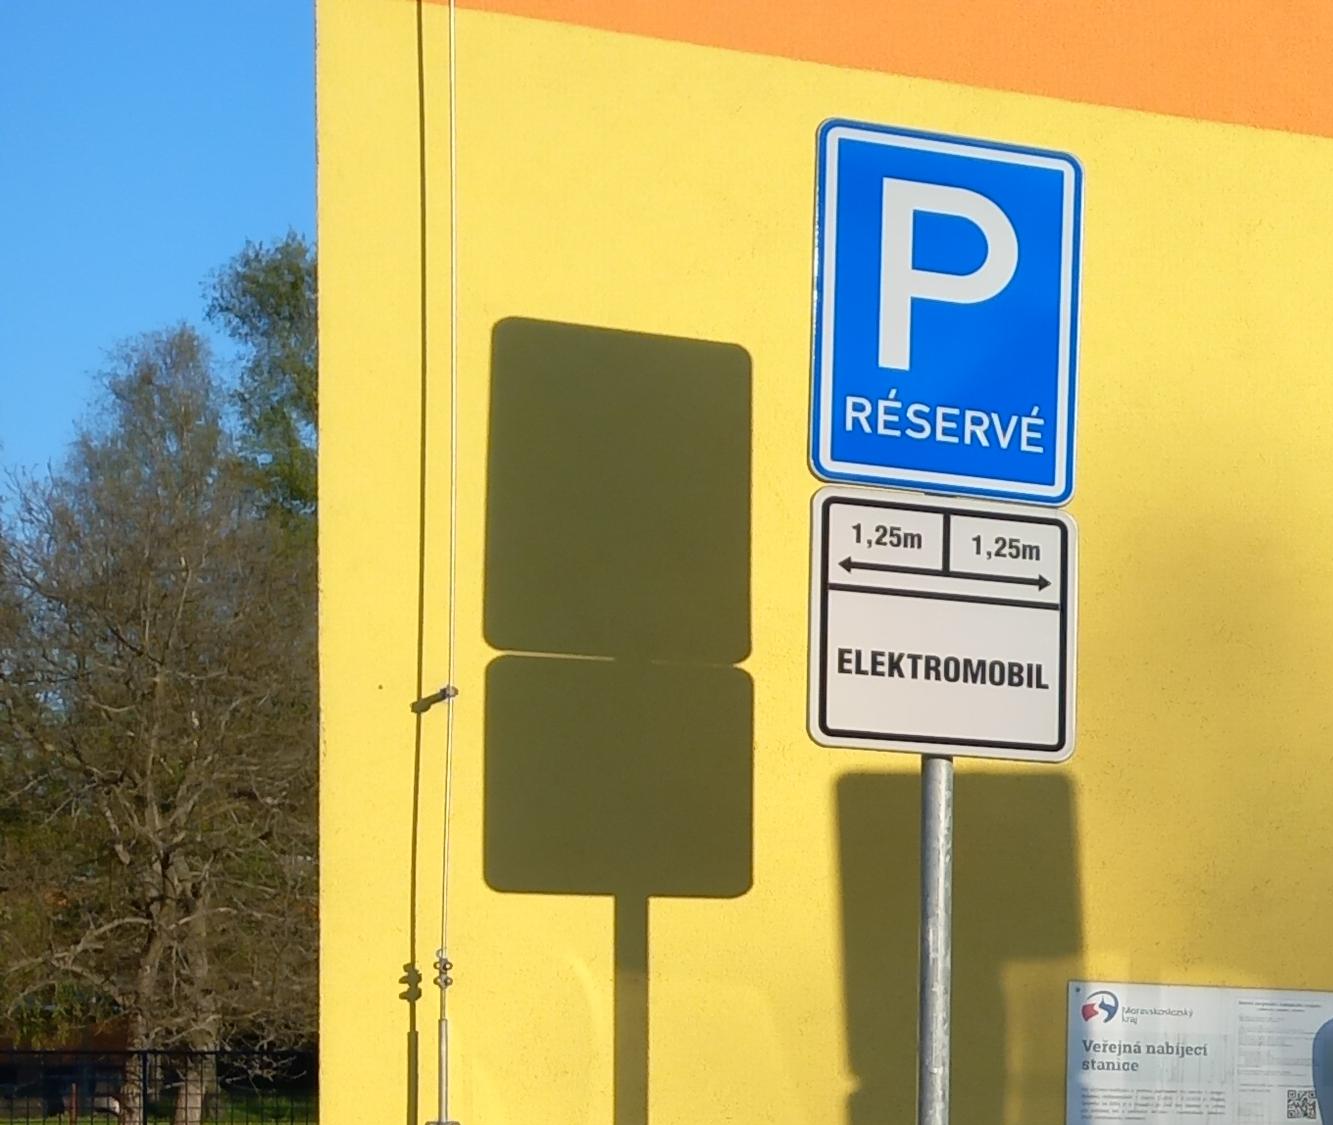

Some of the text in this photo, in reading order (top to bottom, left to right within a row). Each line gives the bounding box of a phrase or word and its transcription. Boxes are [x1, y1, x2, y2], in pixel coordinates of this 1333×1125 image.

[878, 177, 1019, 371] P
[844, 389, 1045, 454] RÉSERVÉ
[851, 522, 923, 551] 1,25m
[971, 534, 1041, 562] 1,25m
[837, 648, 1050, 691] ELEKTROMOBIL
[1082, 1039, 1208, 1058] Veřejná nabíjecí
[1082, 1059, 1139, 1071] stanice
